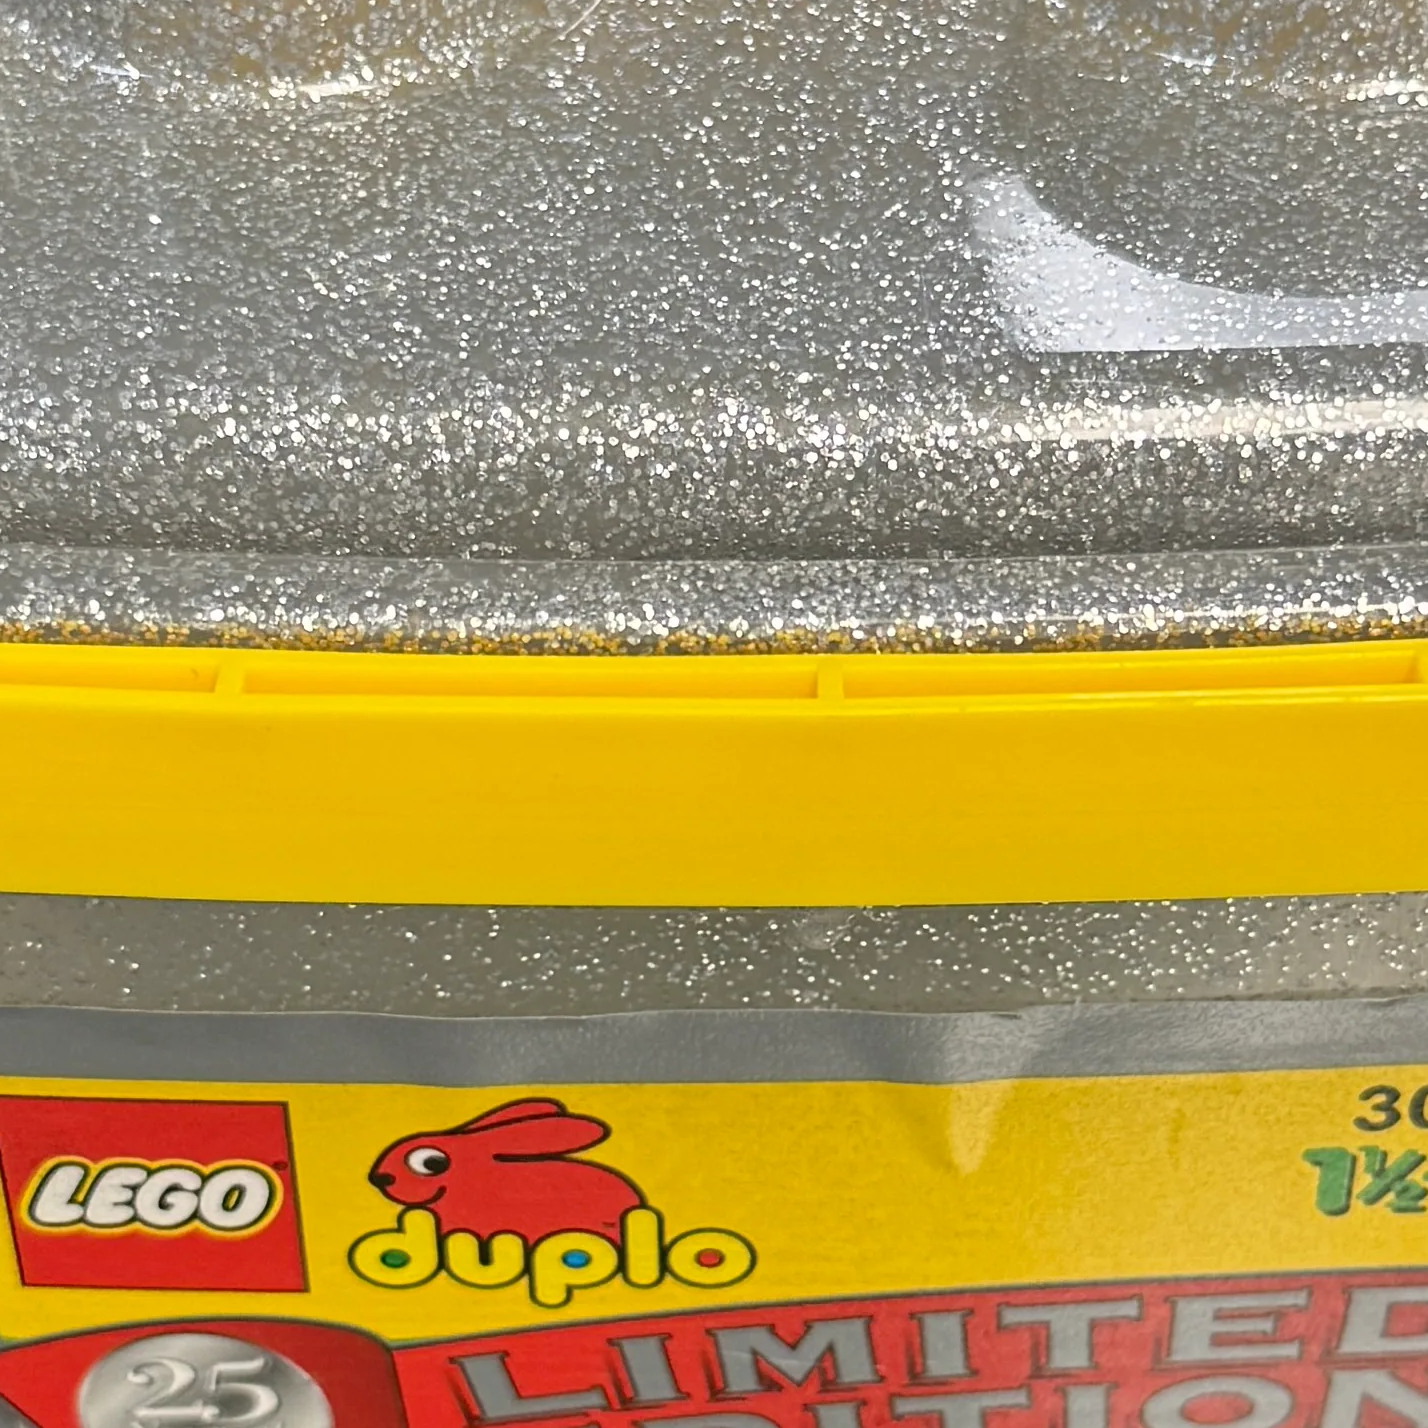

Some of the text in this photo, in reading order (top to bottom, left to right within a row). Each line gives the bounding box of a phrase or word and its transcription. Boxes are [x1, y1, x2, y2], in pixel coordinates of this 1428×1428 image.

[29, 1159, 276, 1235] LEGO
[347, 1204, 757, 1309] duplo
[126, 1355, 280, 1423] 25
